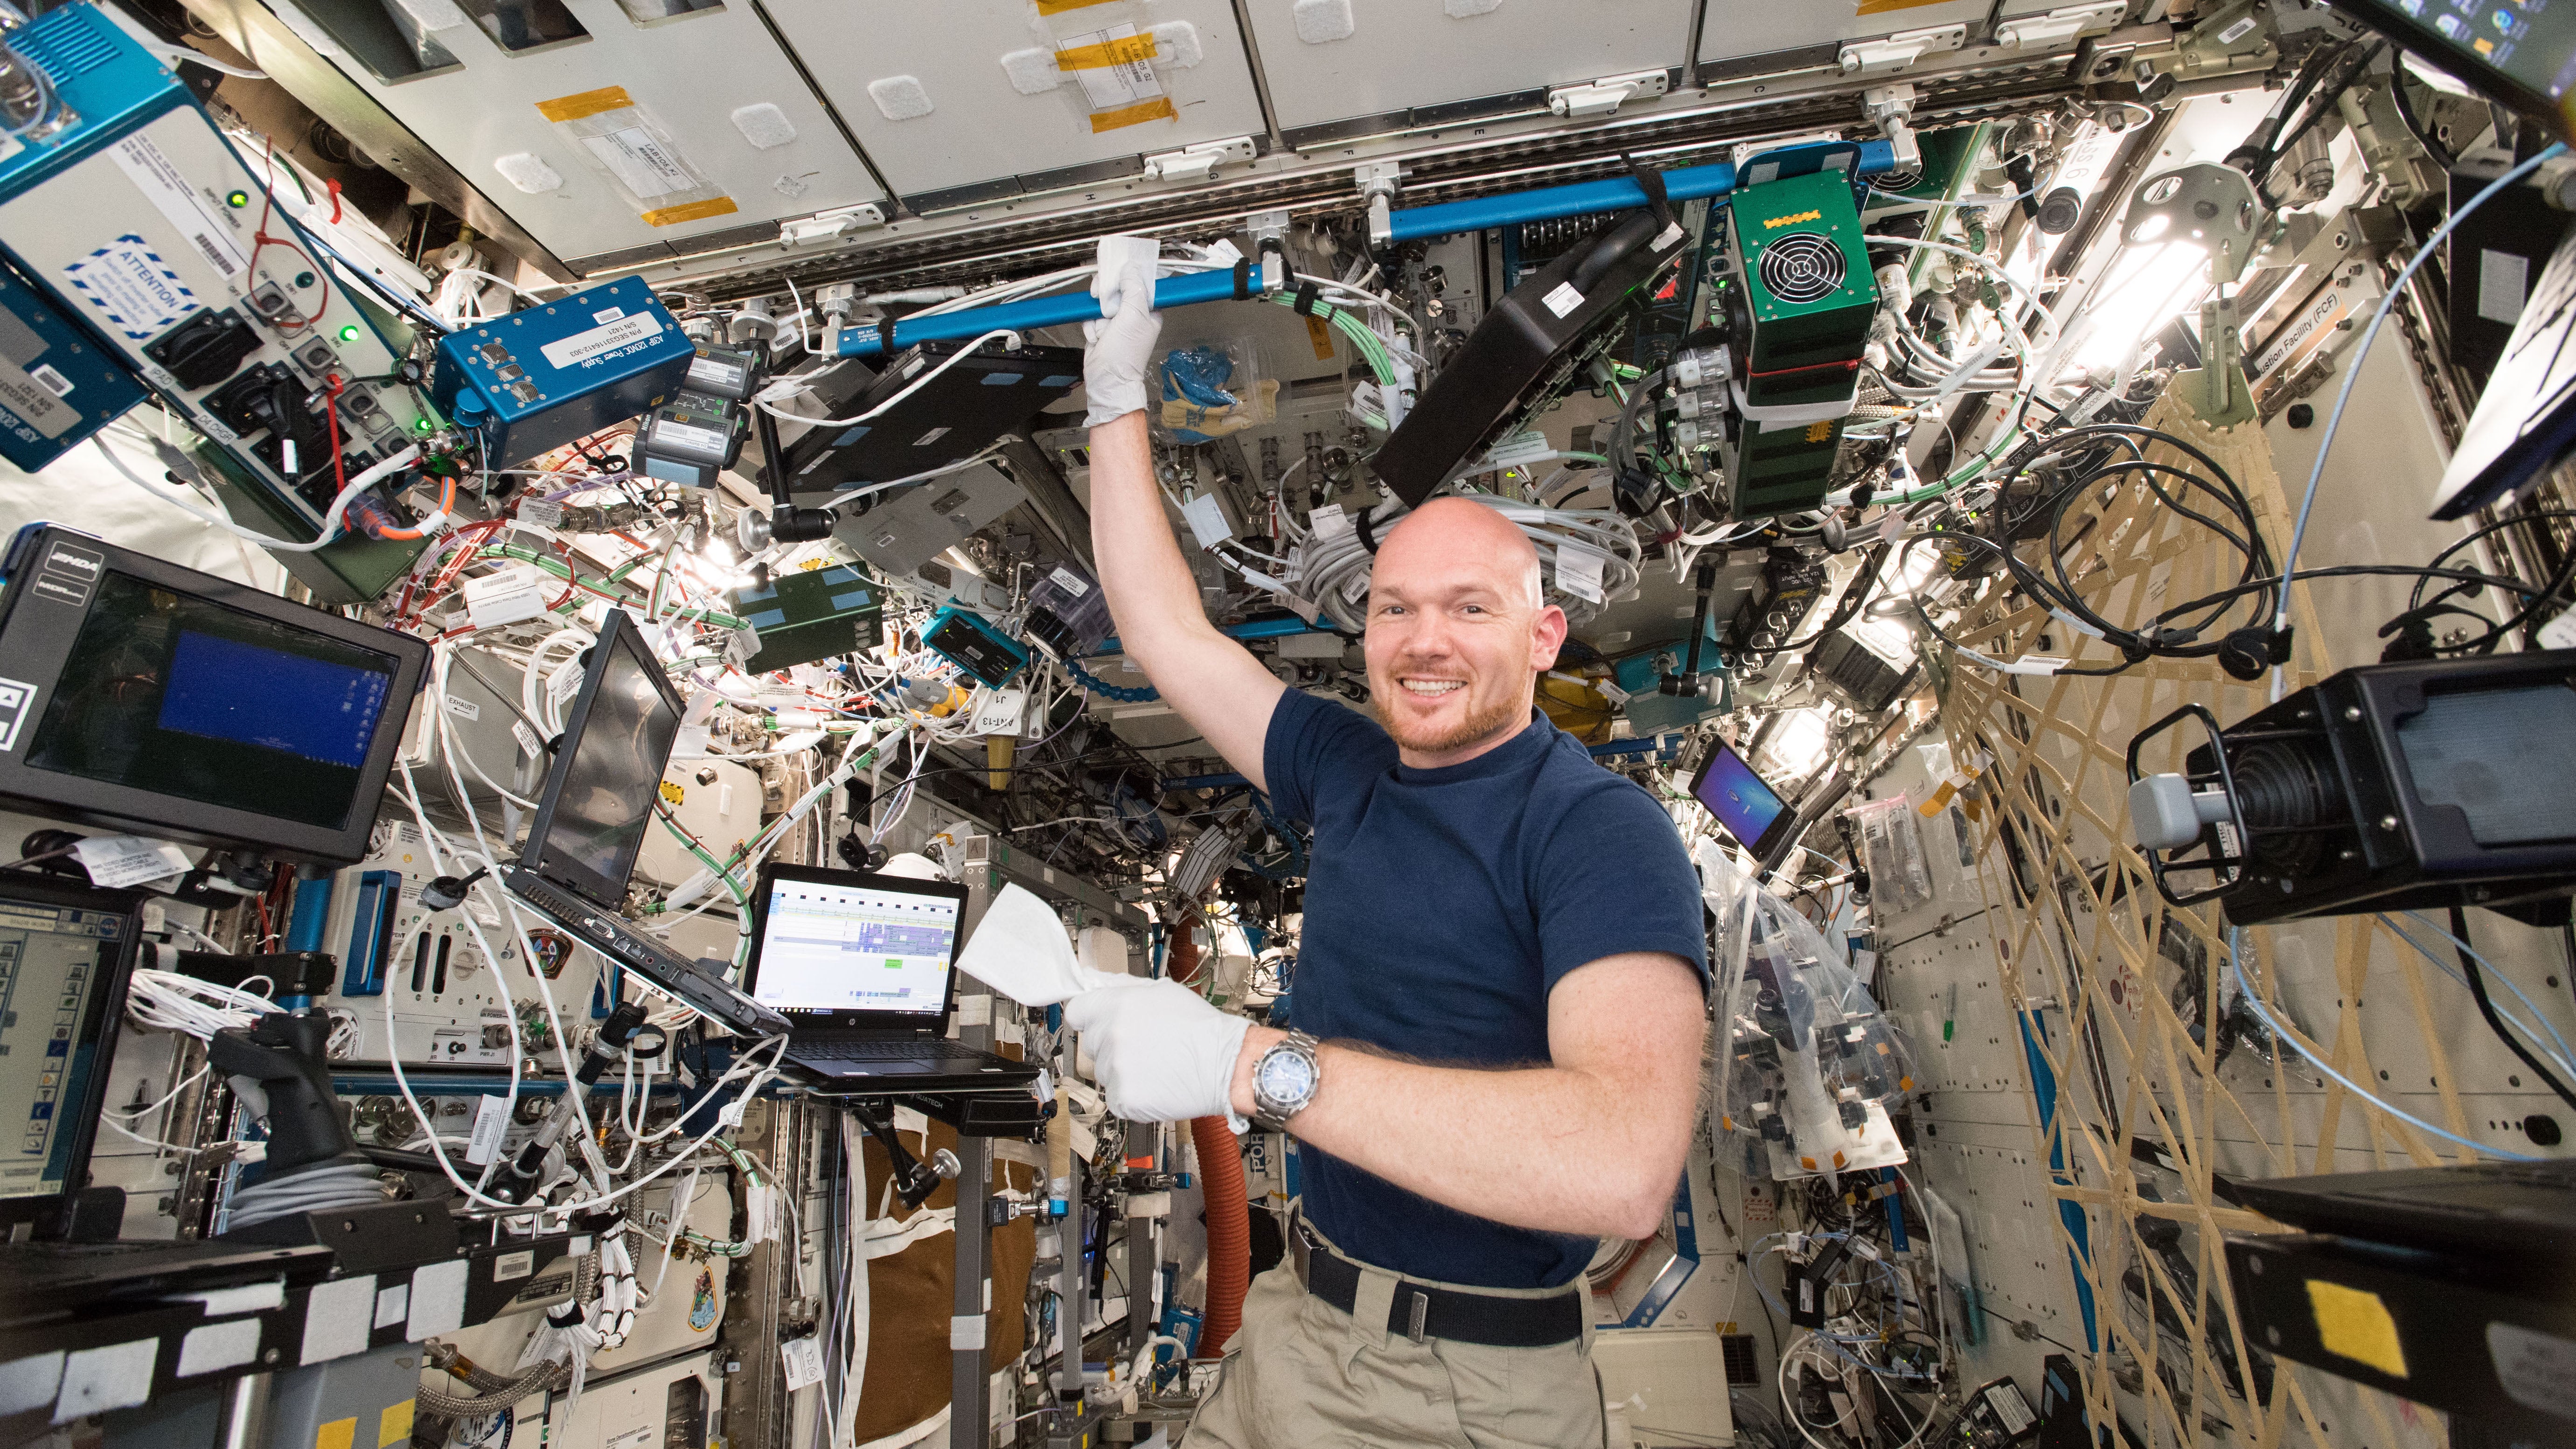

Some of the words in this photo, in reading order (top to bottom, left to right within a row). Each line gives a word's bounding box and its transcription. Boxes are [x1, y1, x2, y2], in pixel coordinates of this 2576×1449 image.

[120, 248, 179, 310] ATTENTION
[624, 321, 636, 331] S/N
[2282, 317, 2315, 351] Facility
[2310, 293, 2340, 323] (FCF)
[608, 326, 624, 336] 1421
[630, 328, 641, 337] P/N
[570, 333, 629, 357] SEG33116412-303
[623, 341, 647, 355] 120VDC
[581, 355, 603, 370] Supply
[604, 349, 624, 362] Power
[2072, 414, 2081, 422] HD
[2080, 393, 2104, 416] ENCODER
[198, 413, 211, 426] D4
[209, 421, 234, 443] CHGR
[641, 414, 651, 431] Nikon
[2011, 454, 2023, 465] 120
[2024, 443, 2036, 454] VDC
[903, 577, 918, 587] MAKITA
[917, 583, 936, 594] CHARGER
[448, 697, 476, 712] EXHAUST
[996, 695, 1006, 705] J1
[982, 716, 1013, 727] ANT-13
[915, 1094, 943, 1109] QUATECH
